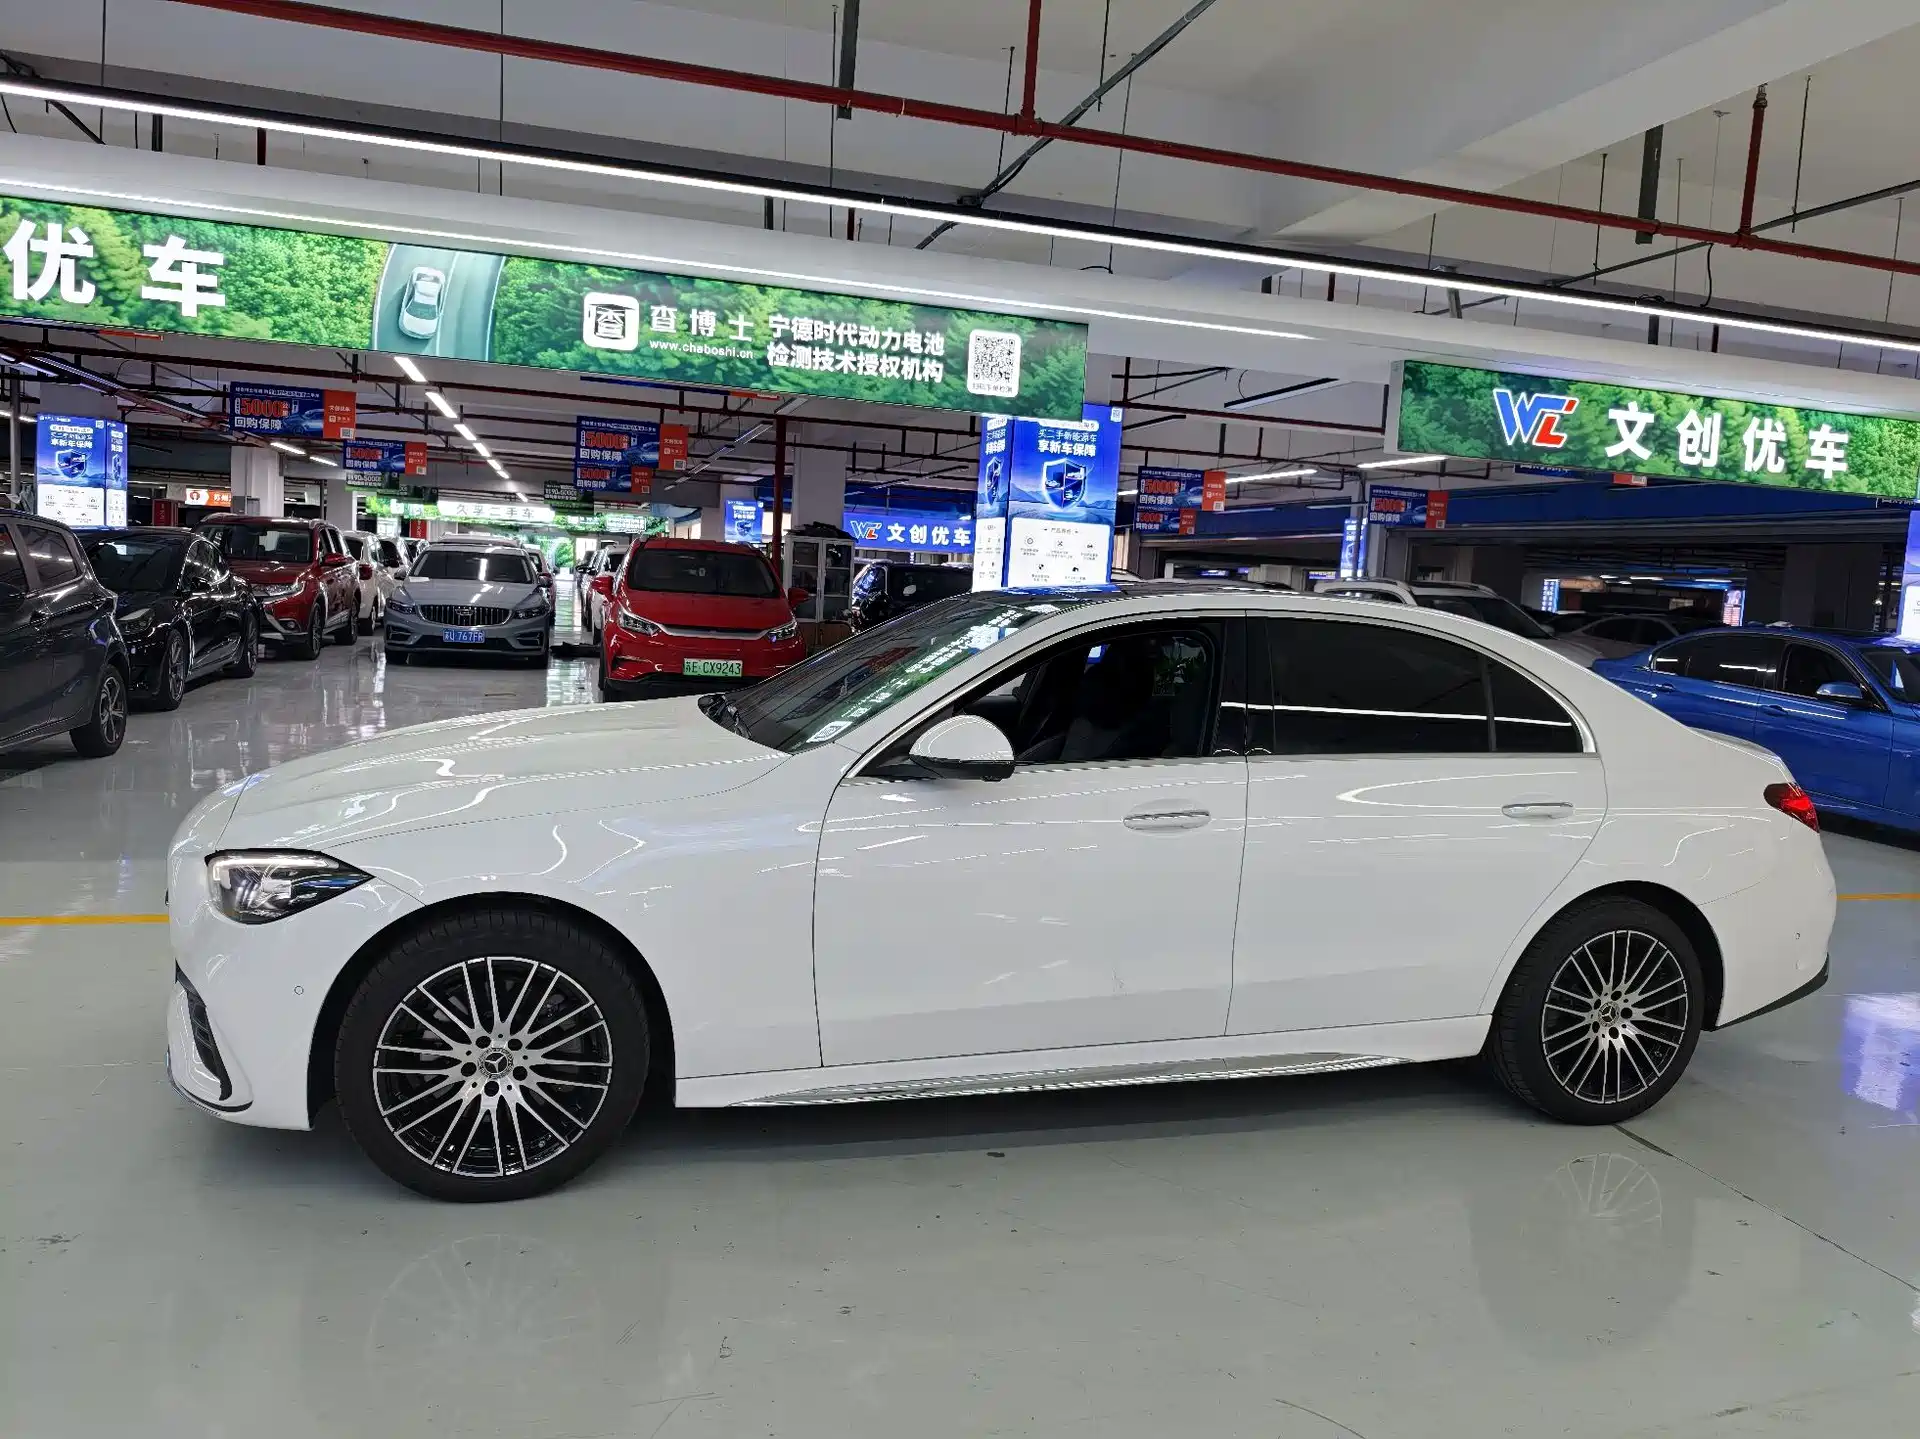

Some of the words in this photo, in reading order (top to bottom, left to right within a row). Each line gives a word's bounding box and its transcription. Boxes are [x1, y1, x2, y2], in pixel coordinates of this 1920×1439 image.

[3, 219, 226, 317] 优车
[650, 305, 754, 342] 查博士
[768, 313, 945, 357] 宁德时代动力电池
[649, 340, 754, 360] www.chaboshi.cn
[766, 342, 944, 383] 检测技术授权机构
[234, 416, 283, 431] 回购保障
[1037, 440, 1097, 457] 享新车保障
[1604, 400, 1849, 479] 文创优车
[579, 448, 622, 462] 回购保障
[1139, 495, 1174, 506] 回购保障
[886, 523, 973, 547] 文创优车
[703, 661, 742, 675] CX9243
